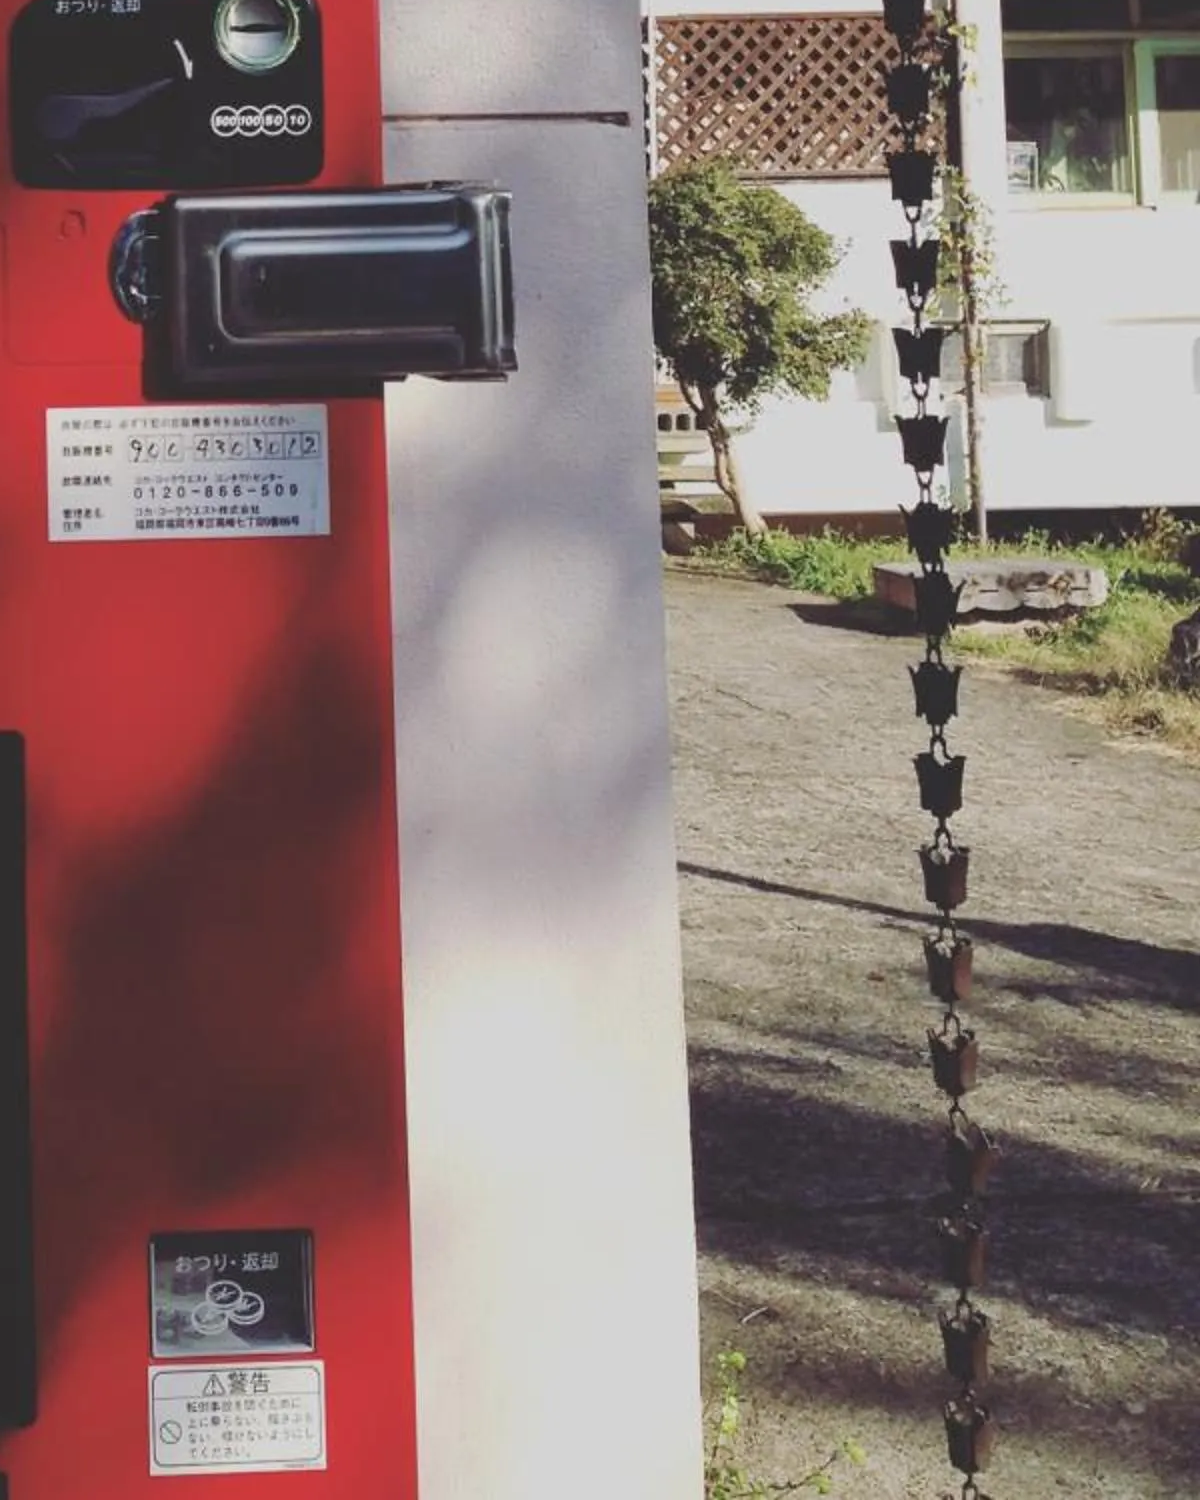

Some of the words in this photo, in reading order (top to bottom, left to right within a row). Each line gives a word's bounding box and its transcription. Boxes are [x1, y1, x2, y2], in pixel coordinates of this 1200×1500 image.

[215, 113, 239, 127] 500
[240, 113, 262, 126] 100
[264, 113, 284, 126] 50
[290, 112, 306, 125] 10
[175, 1251, 280, 1274] おつり・返却
[227, 1371, 271, 1395] 警告
